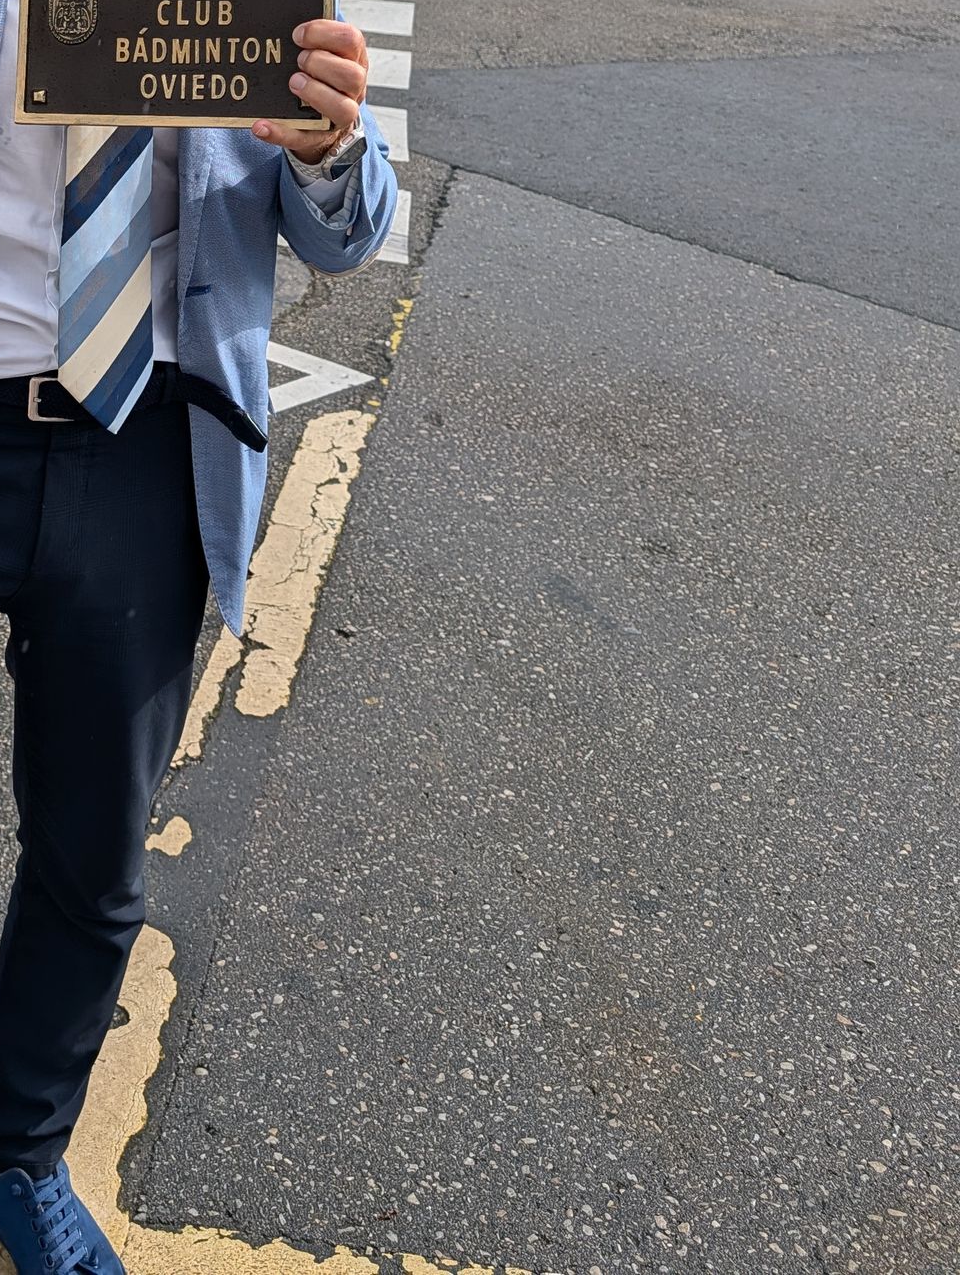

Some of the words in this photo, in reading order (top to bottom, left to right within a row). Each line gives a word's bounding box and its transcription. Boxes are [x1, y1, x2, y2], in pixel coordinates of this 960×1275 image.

[157, 0, 233, 26] CLUB
[116, 28, 281, 64] BÁDMINTON
[140, 73, 248, 101] OVIEDO
